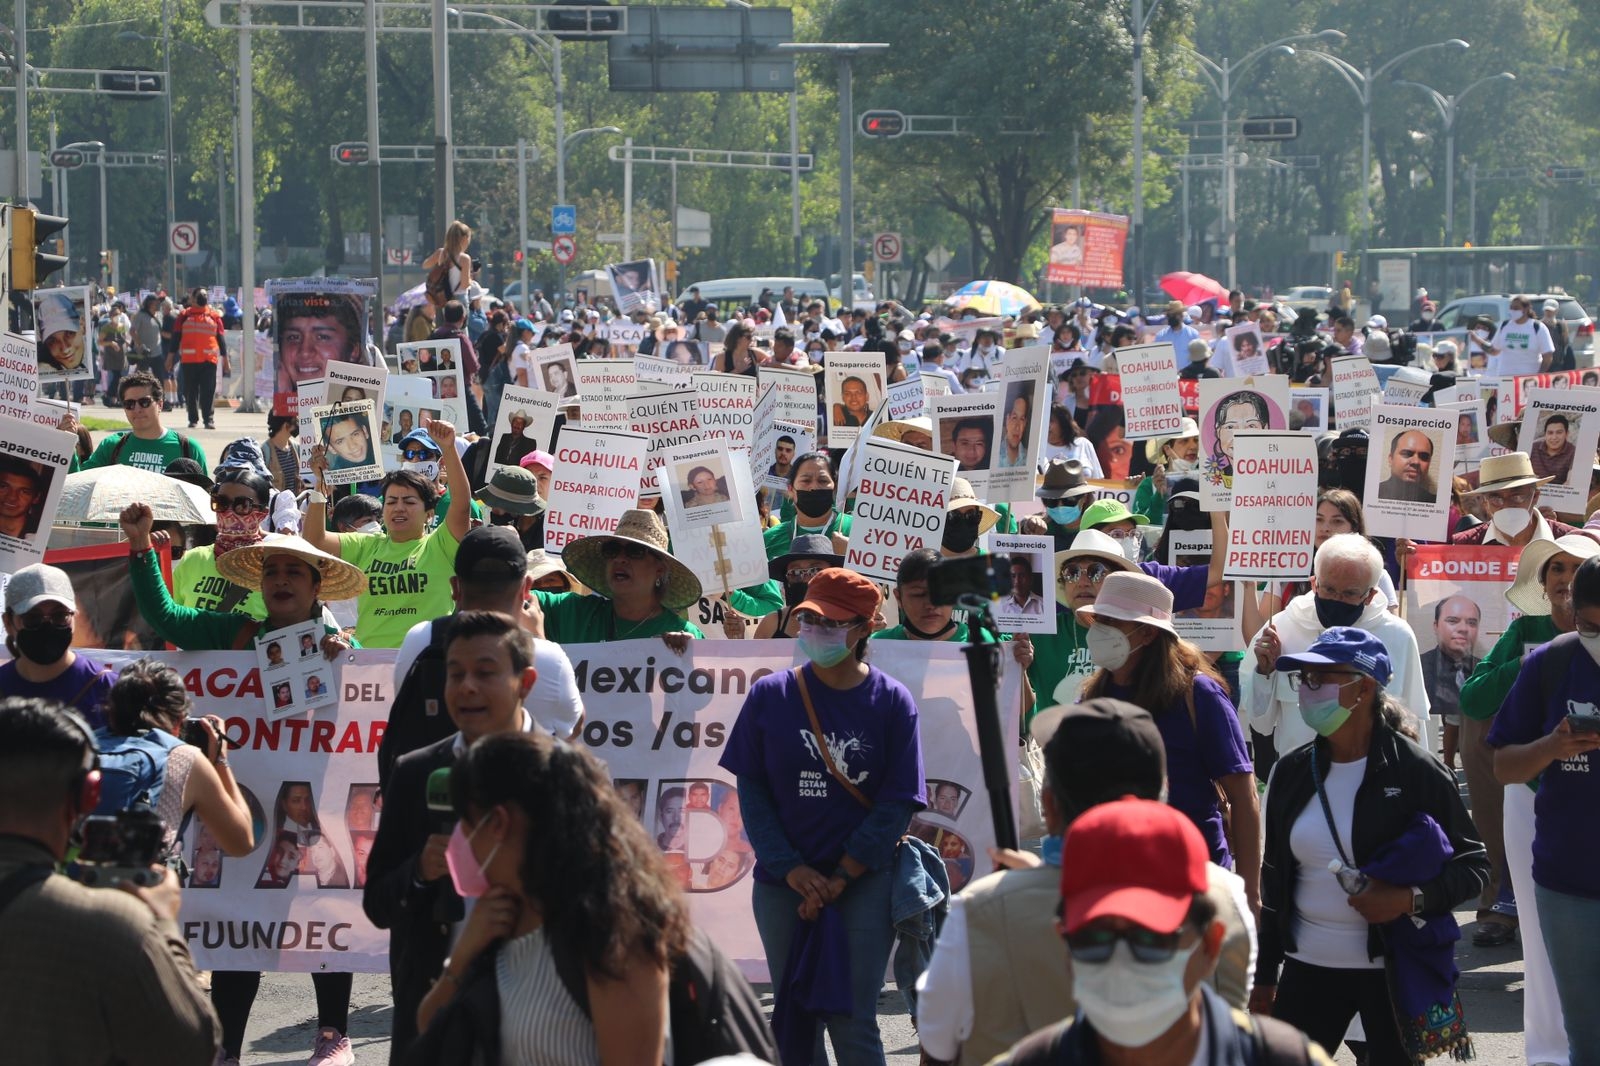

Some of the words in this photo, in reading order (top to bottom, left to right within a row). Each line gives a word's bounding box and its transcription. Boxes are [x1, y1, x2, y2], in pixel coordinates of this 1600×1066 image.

[829, 361, 881, 369] Desaparecido
[1121, 359, 1174, 374] COAHUILA
[329, 371, 381, 386] Desaparecido
[581, 375, 601, 384] GRAN
[603, 375, 635, 384] FRACASO
[1335, 373, 1352, 382] GRAN
[741, 383, 754, 393] TE
[783, 385, 815, 394] FRACASO
[1124, 381, 1177, 395] DESAPARICIÓN
[1335, 390, 1355, 400] ESTADO
[504, 392, 552, 409] Desaparecido
[698, 396, 753, 409] USCARÁ
[1532, 400, 1598, 413] Desaparecido
[314, 404, 372, 418] DESAPARECIDO
[630, 401, 678, 419] ¿QUIÉN
[682, 400, 697, 412] TE
[891, 400, 924, 416] BUSCA
[936, 403, 996, 413] Desaparecido
[1127, 408, 1137, 418] EL
[1140, 403, 1179, 417] CRIMEN
[1336, 410, 1347, 419] NO
[1347, 407, 1371, 418] ENCONT
[582, 413, 593, 421] NO
[595, 413, 628, 421] ENCONTR
[700, 413, 753, 425] UANDO
[1377, 414, 1452, 430] Desaparecido
[631, 415, 700, 434] BUSCARÁ
[1127, 417, 1180, 433] PERFECTO
[729, 430, 745, 441] YA
[595, 439, 606, 447] EN
[1268, 443, 1279, 452] EN
[0, 440, 69, 466] aparecido
[559, 448, 639, 471] COAHUILA
[673, 449, 719, 461] Desaparecida
[864, 457, 927, 481] ¿QUIÉN
[932, 468, 951, 486] TE
[1237, 458, 1314, 475] COAHUILA
[589, 472, 599, 480] LA
[554, 480, 636, 500] DESAPARICIÓN
[1267, 480, 1276, 489] LA
[860, 478, 945, 509] BUSCARÁ
[1235, 493, 1314, 507] DESAPARICIÓN
[547, 510, 564, 526] EL
[569, 513, 618, 532] CRIME
[857, 502, 940, 532] CUANDO
[863, 528, 898, 547] ¿YO
[903, 533, 924, 551] YA
[996, 540, 1047, 549] Desaparecido
[1231, 530, 1247, 545] EL
[1252, 530, 1311, 545] CRIMEN
[1174, 543, 1212, 551] Desapar
[848, 548, 877, 568] NO
[1229, 552, 1309, 568] PERFECTO
[1419, 560, 1500, 577] ¿DONDE
[368, 572, 428, 597] ESTAN?
[374, 606, 417, 617] #Fundem
[344, 683, 386, 702] DEL
[650, 711, 726, 751] /as
[800, 771, 822, 780] #NO
[799, 779, 827, 789] ESTÁN
[799, 789, 828, 797] SOLAS
[184, 920, 352, 952] FUUNDEC
